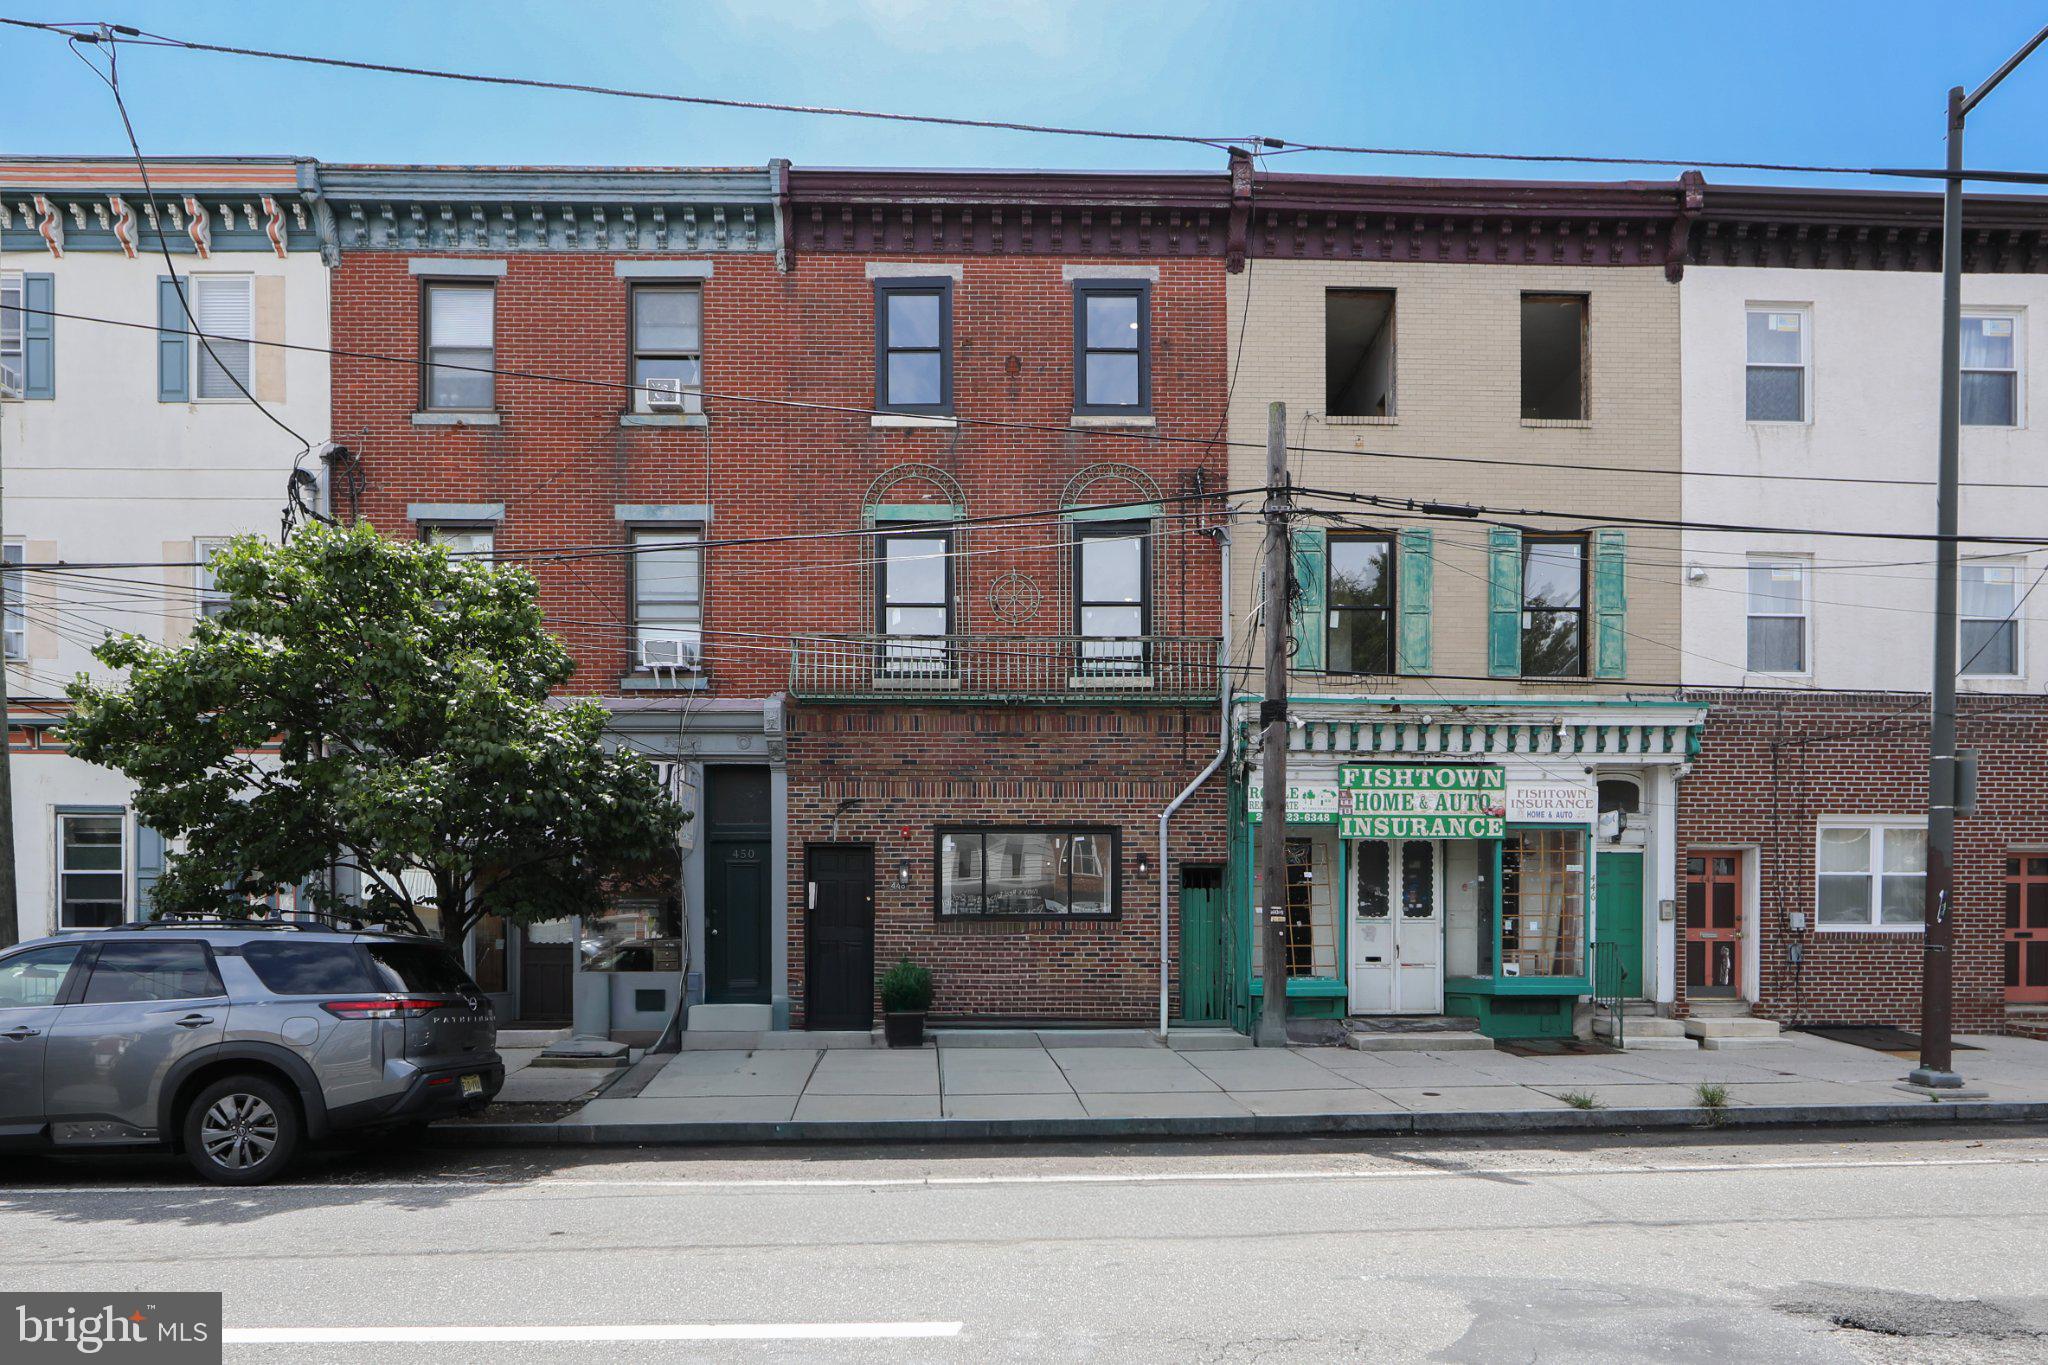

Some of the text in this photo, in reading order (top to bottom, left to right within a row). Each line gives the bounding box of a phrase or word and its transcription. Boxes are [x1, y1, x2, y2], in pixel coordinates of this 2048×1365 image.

[1341, 768, 1503, 787] FISHTOWN
[1517, 789, 1587, 799] FISHTOWN
[1354, 792, 1492, 811] HOME & AUTO
[1511, 799, 1594, 809] INSURANCE
[1255, 813, 1330, 822] 223-6348
[1526, 810, 1545, 818] HOME
[1555, 811, 1573, 819] AUTO
[1341, 817, 1504, 837] INSURANCE
[732, 849, 755, 859] 450
